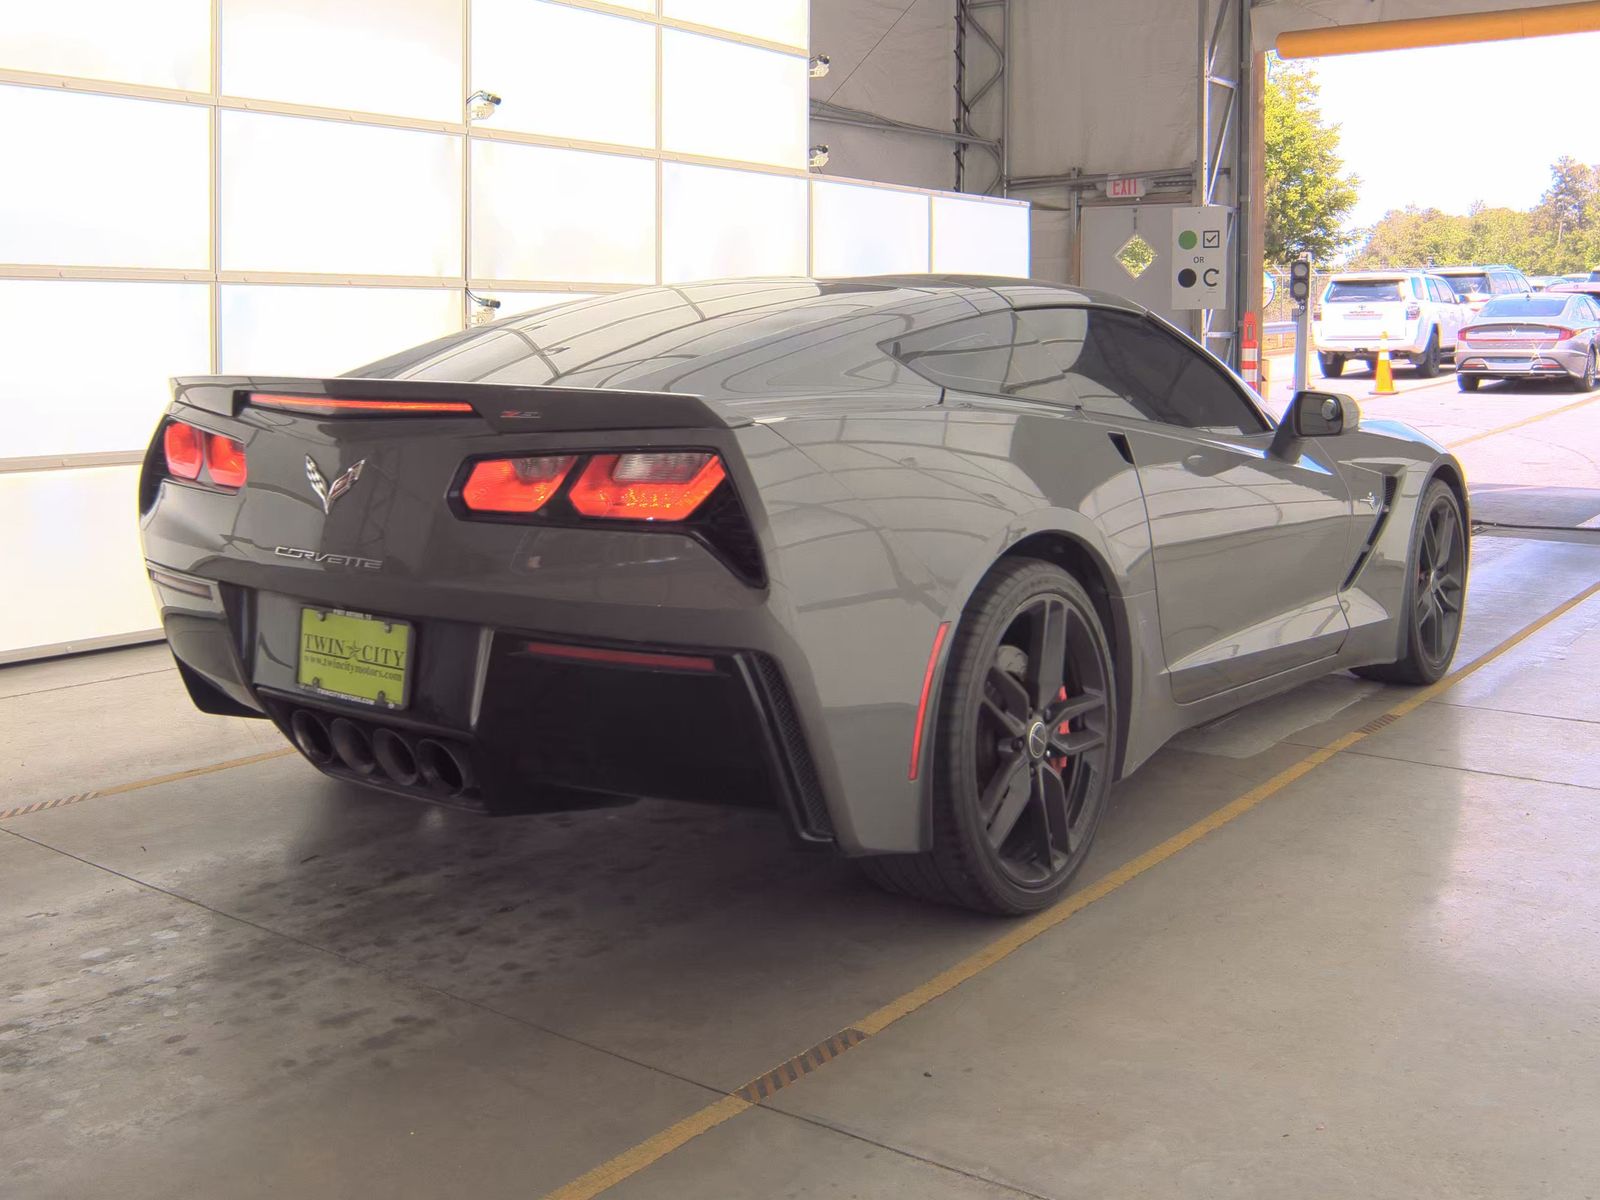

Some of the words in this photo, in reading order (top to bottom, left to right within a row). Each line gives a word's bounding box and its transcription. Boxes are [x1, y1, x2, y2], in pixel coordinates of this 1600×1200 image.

[1193, 256, 1205, 264] OR
[274, 546, 383, 569] CORVETTE
[304, 634, 346, 656] TWIN
[361, 645, 405, 667] CITY
[303, 656, 402, 682] www.twincitymotors.com
